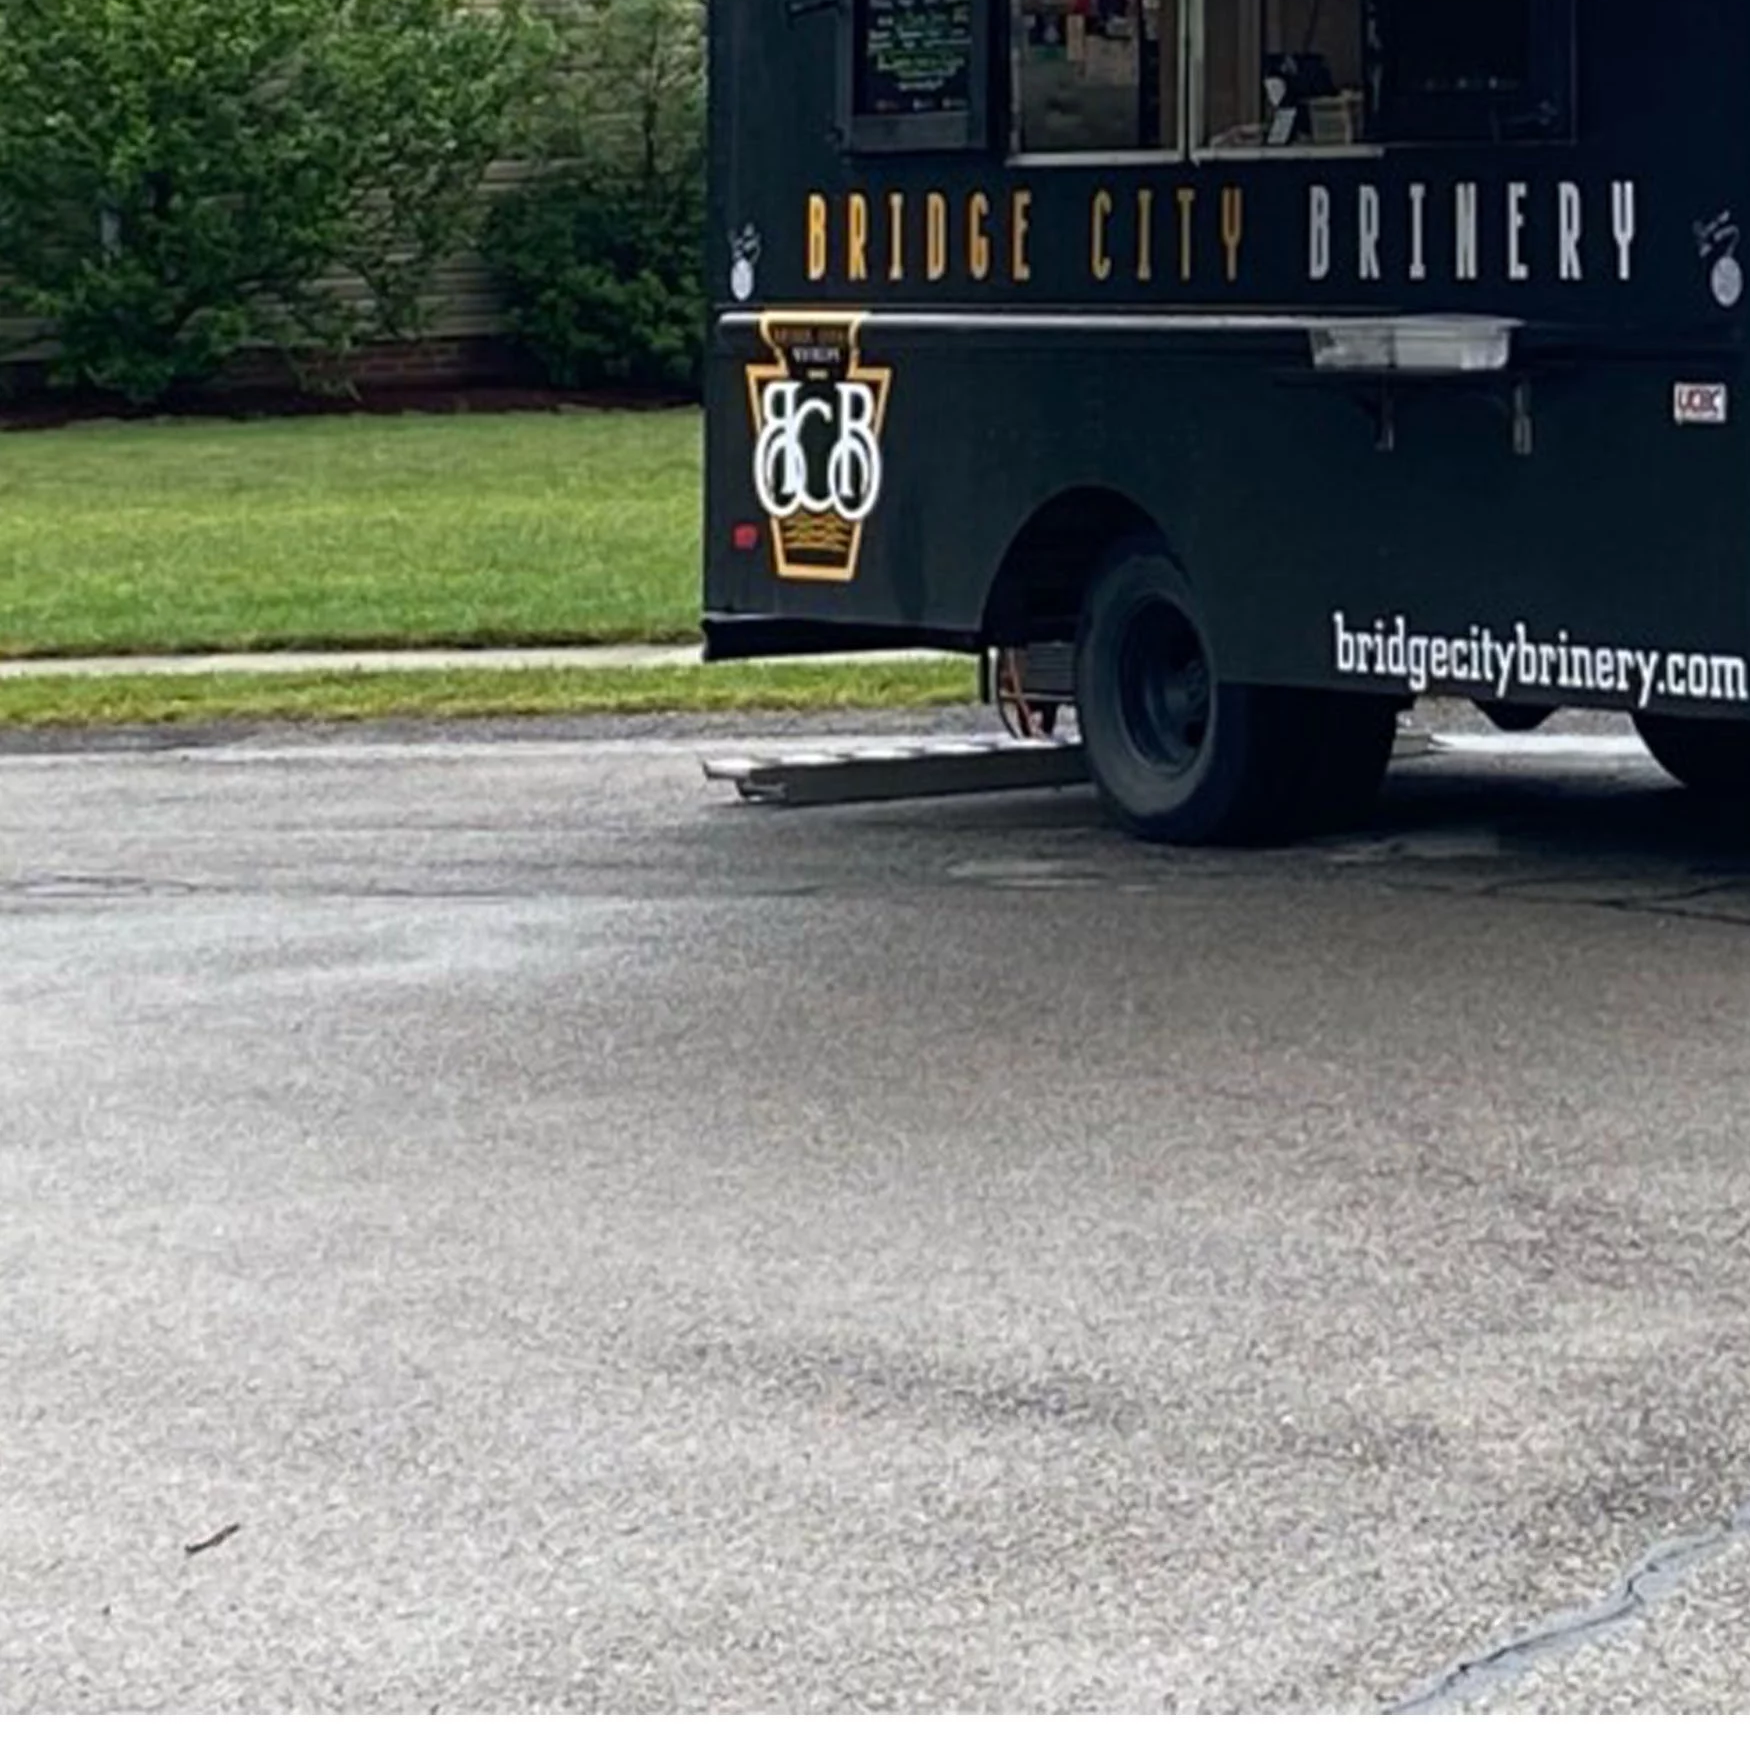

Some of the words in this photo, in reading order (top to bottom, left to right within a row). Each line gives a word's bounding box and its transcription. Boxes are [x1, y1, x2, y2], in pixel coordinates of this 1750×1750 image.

[807, 192, 1031, 282] BRIDGE
[1091, 189, 1241, 280] CITY
[1309, 179, 1637, 282] BRINERY
[1333, 611, 1750, 709] bridgecitybrinery.com
